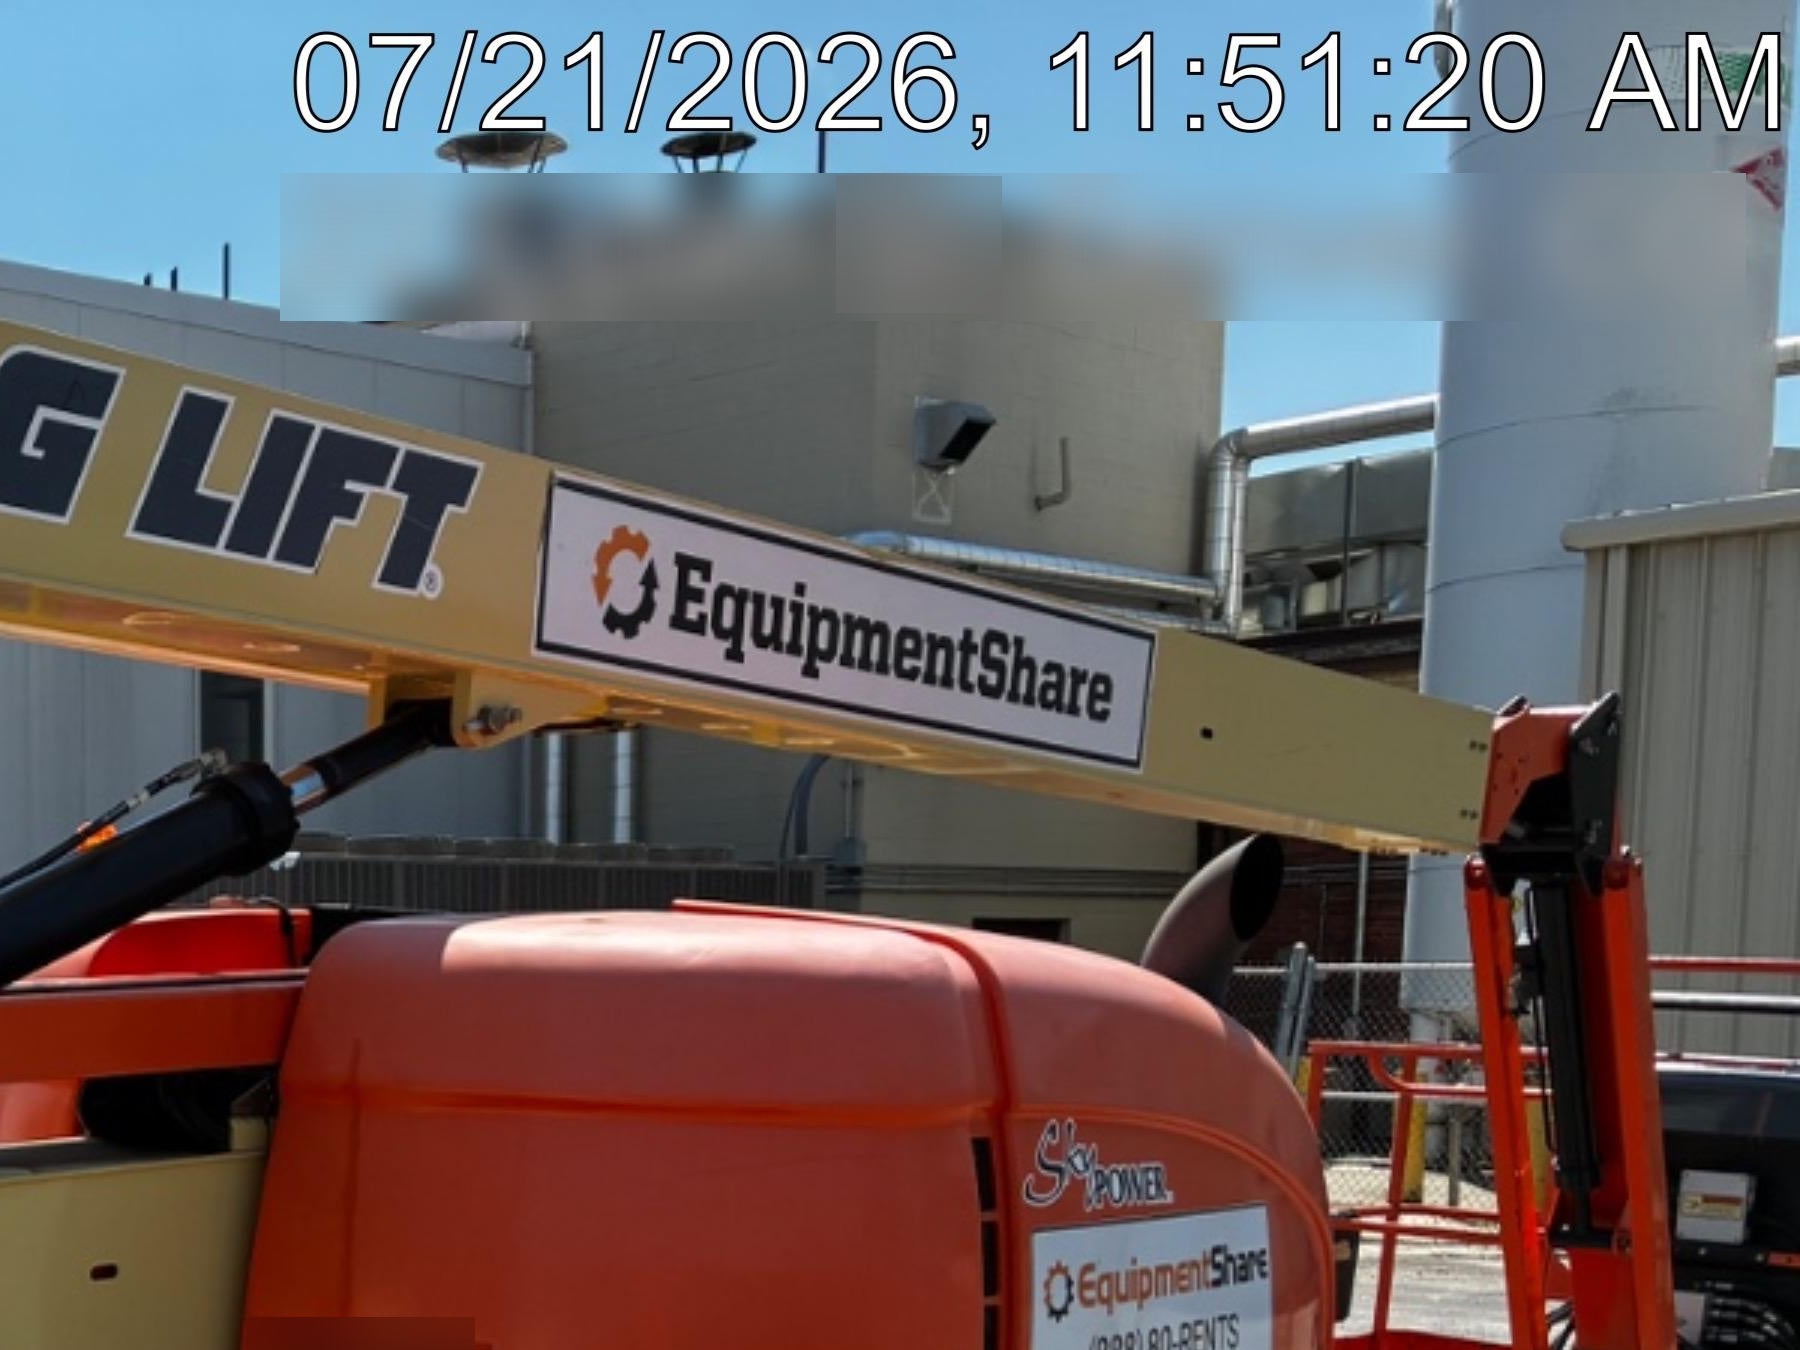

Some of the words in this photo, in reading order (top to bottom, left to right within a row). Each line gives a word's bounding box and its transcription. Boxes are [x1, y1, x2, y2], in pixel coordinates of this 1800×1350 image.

[667, 551, 1114, 723] EquipmentShare
[1090, 1161, 1168, 1206] POWER
[1077, 1244, 1268, 1315] EquipmentShare
